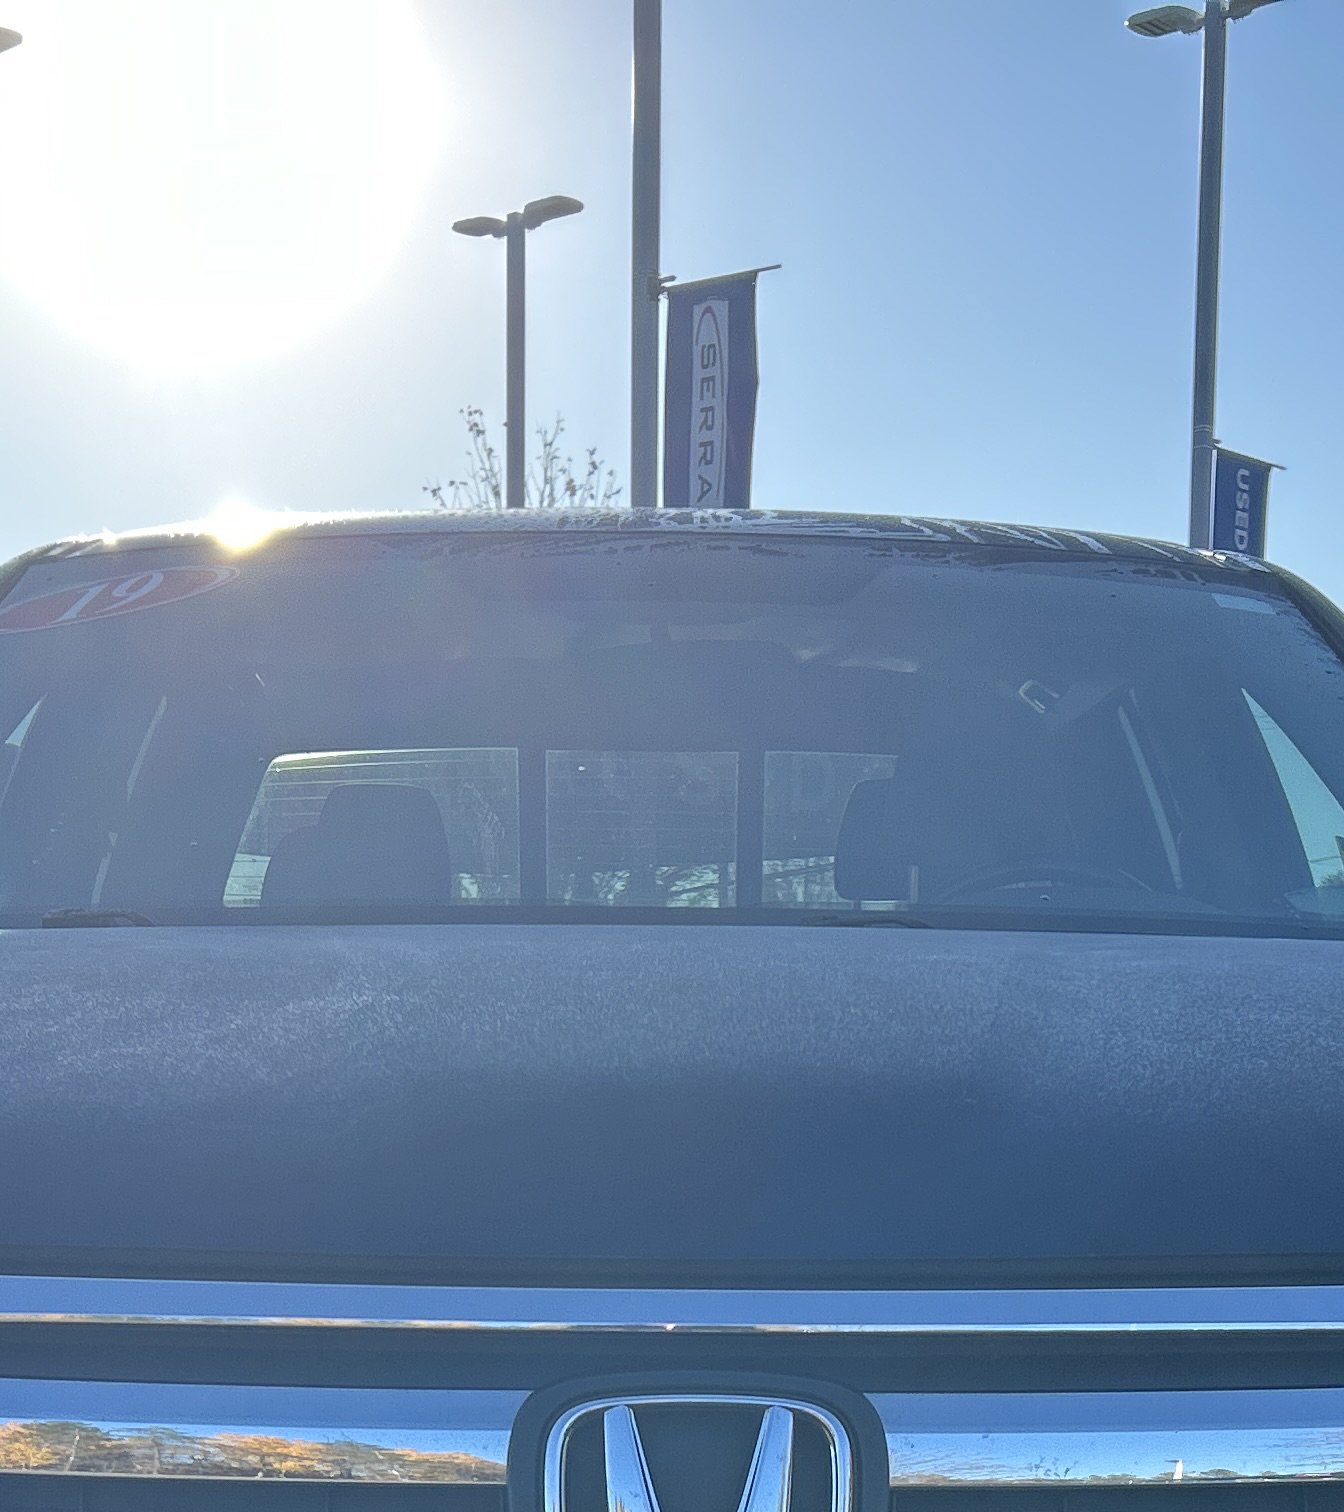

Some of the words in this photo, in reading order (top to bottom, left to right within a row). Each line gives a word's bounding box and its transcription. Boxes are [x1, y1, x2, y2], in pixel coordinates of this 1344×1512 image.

[696, 343, 717, 503] SERRA
[1234, 468, 1250, 550] USED
[48, 570, 164, 624] 19
